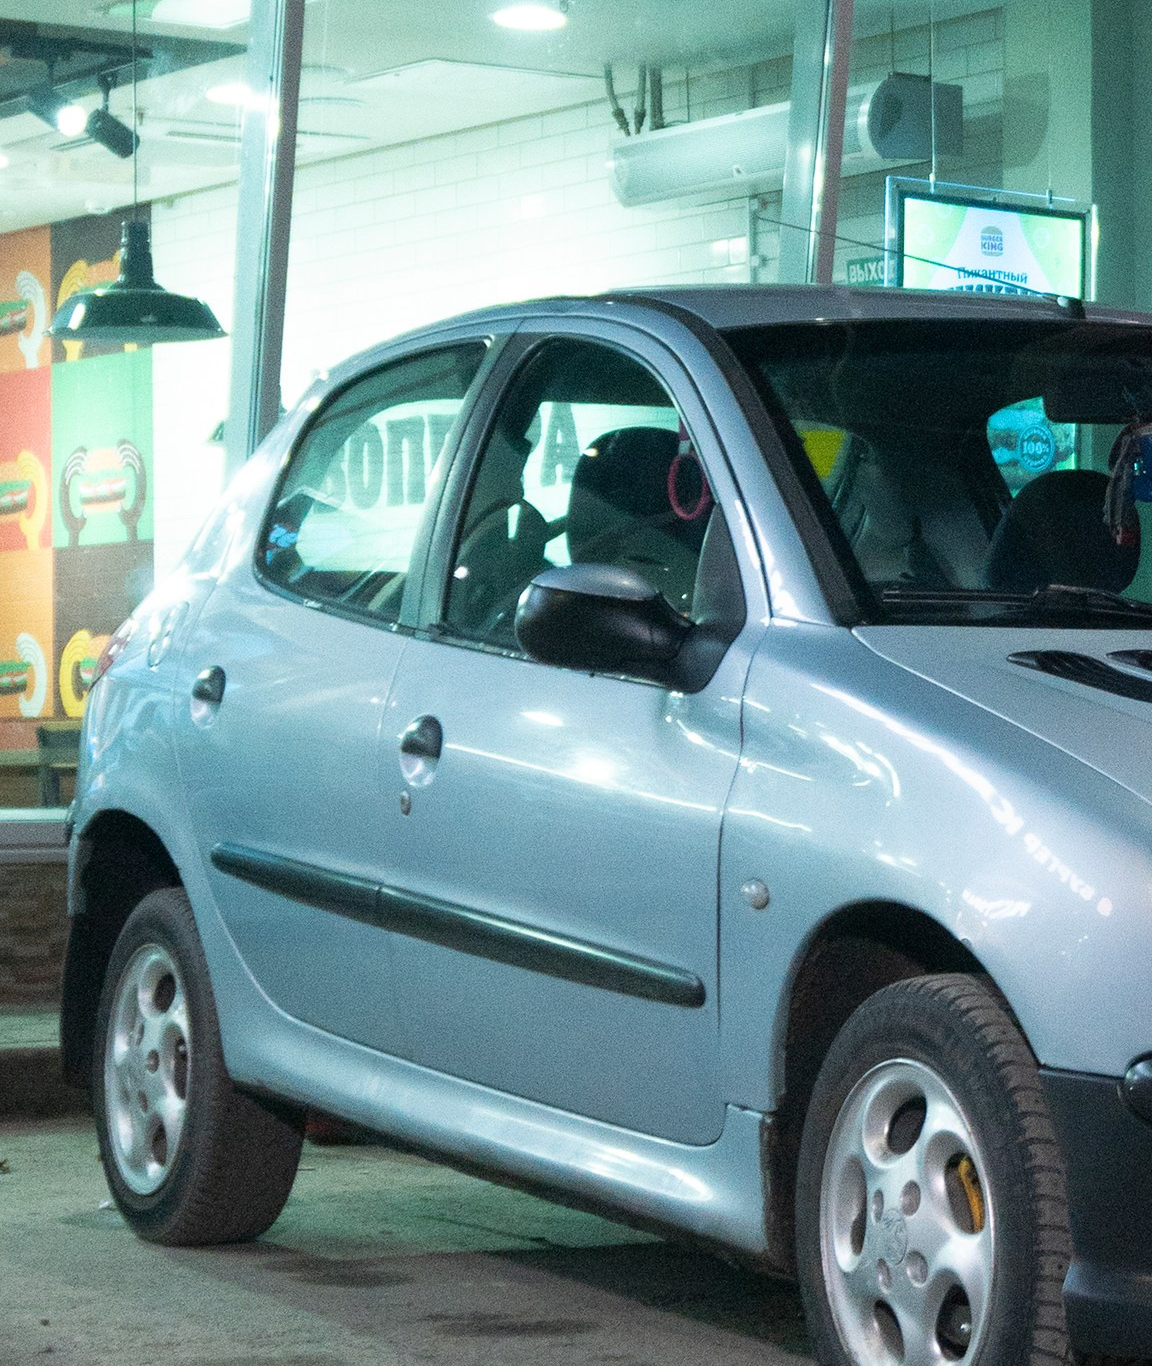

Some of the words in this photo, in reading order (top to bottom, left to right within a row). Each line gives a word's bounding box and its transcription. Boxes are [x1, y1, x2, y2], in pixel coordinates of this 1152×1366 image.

[981, 242, 1003, 251] KING
[957, 266, 1028, 284] Пикантный
[1022, 441, 1049, 455] 100%
